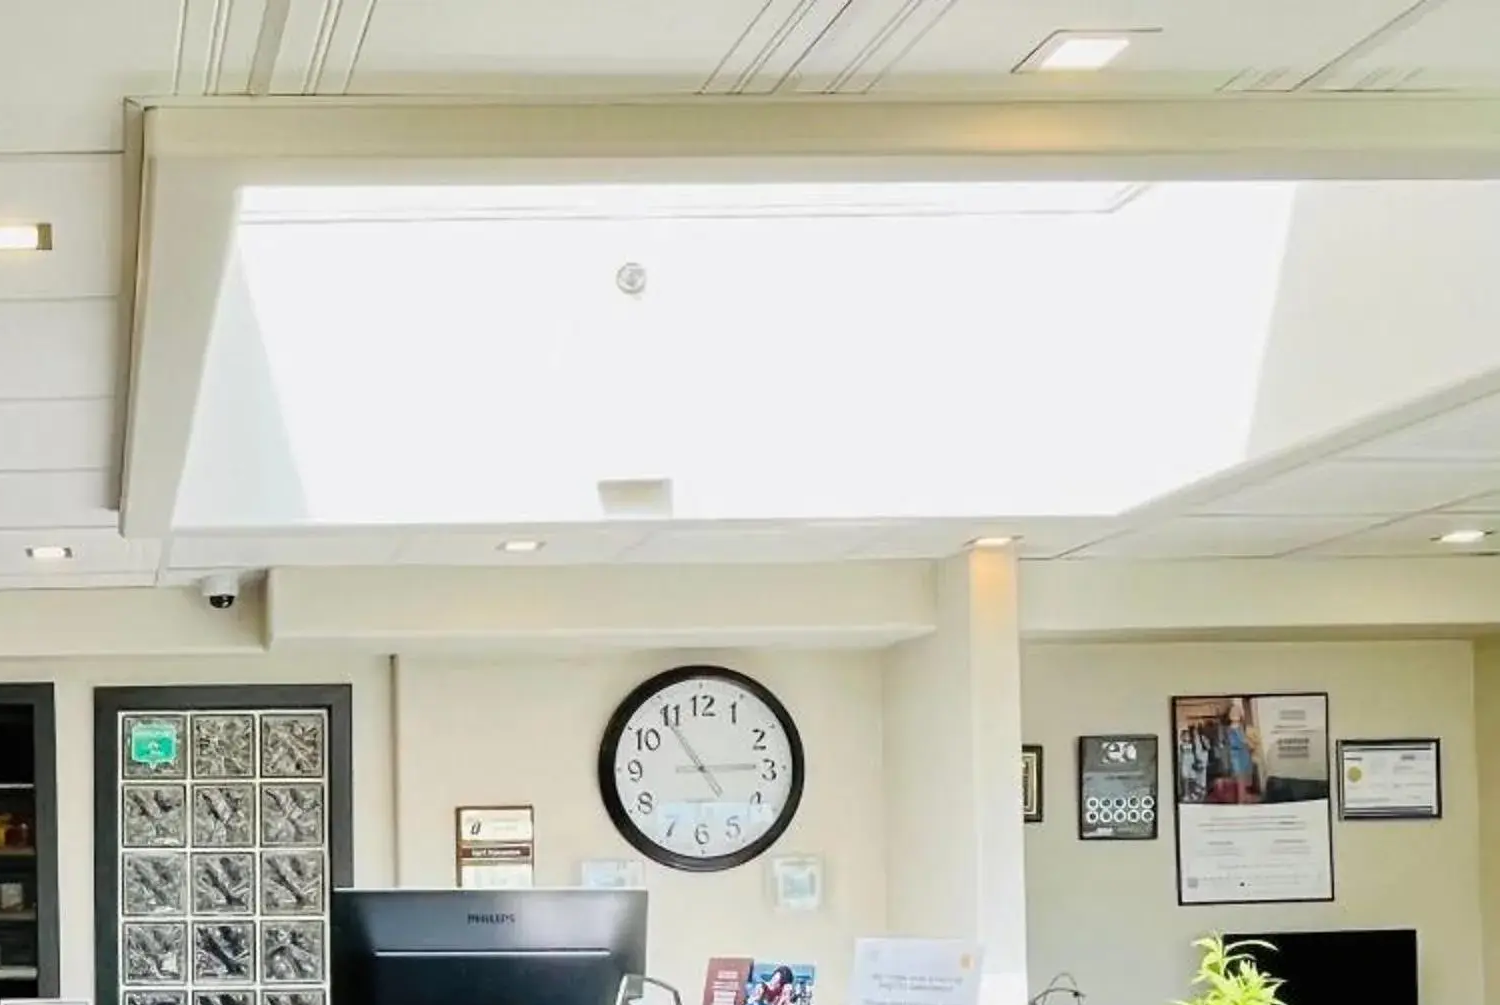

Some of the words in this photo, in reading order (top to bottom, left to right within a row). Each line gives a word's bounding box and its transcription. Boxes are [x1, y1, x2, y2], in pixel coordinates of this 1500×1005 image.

[660, 704, 681, 727] 11
[690, 694, 716, 717] 12
[729, 702, 737, 724] 1
[636, 728, 661, 751] 10
[752, 728, 767, 750] 2
[627, 759, 643, 782] 9
[761, 758, 777, 781] 3
[637, 792, 653, 814] 8
[665, 814, 678, 838] 7
[695, 823, 710, 845] 6
[726, 815, 742, 839] 5
[467, 913, 515, 925] PHILIPS
